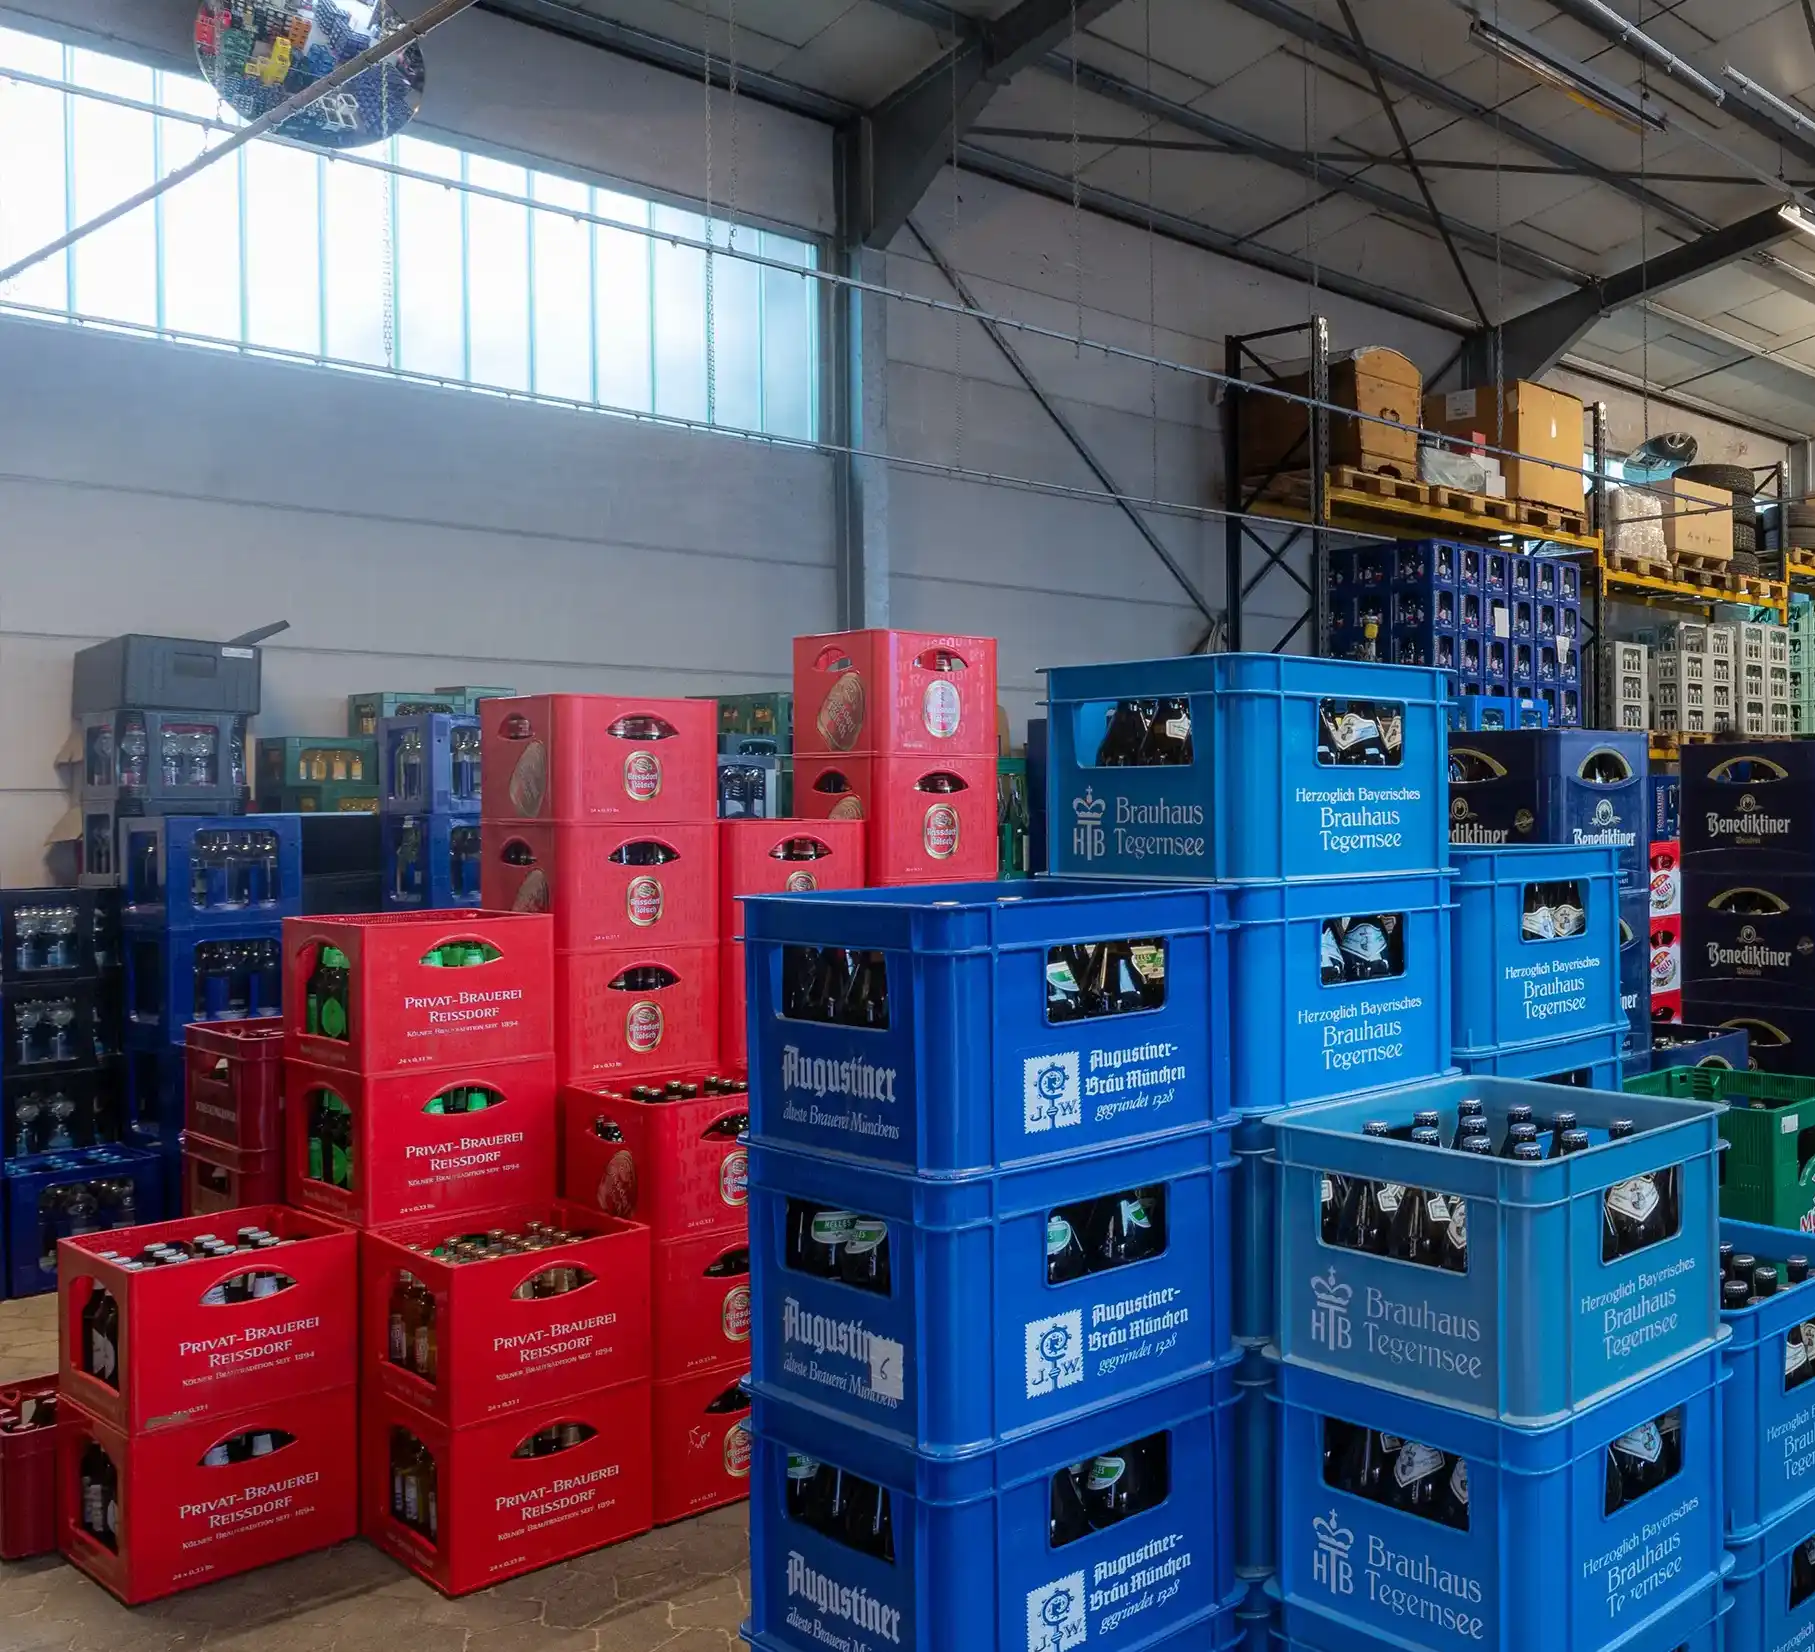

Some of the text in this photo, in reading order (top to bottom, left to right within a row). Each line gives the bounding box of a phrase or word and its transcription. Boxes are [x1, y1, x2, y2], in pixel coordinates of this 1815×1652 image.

[1115, 797, 1204, 826] Brauhaus
[1296, 786, 1421, 804] Herzoglich Bayerisches
[1320, 806, 1401, 828] Brauhaus
[1706, 812, 1791, 838] Benediktiner
[1114, 827, 1205, 858] Tegernsee
[1319, 829, 1402, 853] Tegernsee
[1505, 955, 1600, 980] Herzoglich Bayerisches
[1706, 941, 1792, 967] Benediktiner
[404, 989, 522, 1009] PRIVAT-BRAUEREI
[1523, 976, 1585, 996] Brauhaus
[428, 1007, 500, 1023] REISSDORF
[1298, 997, 1422, 1026] Herzoglich Bayerisches
[1523, 995, 1586, 1020] Tegernsee
[1323, 1019, 1402, 1047] Brauhaus
[782, 1043, 897, 1104] Augustiner
[1090, 1042, 1178, 1072] Augustiner-
[1322, 1042, 1403, 1071] Tegernsee
[1085, 1063, 1186, 1097] Bräu München
[783, 1104, 900, 1141] älteste Brauerei Münchens
[1095, 1089, 1175, 1122] gegründet 1328
[406, 1132, 524, 1159] PRIVAT-BRAUEREI
[430, 1151, 501, 1171] REISSDORF
[824, 1219, 852, 1230] HELLES
[1581, 1256, 1696, 1314] Herzoglich Bayerisches
[1092, 1287, 1181, 1328] Augustiner-
[1366, 1287, 1481, 1343] Brauhaus
[1603, 1287, 1676, 1335] Brauhaus
[179, 1316, 320, 1356] PRIVAT-BRAUEREI
[494, 1313, 617, 1352] PRIVAT-BRAUEREI
[1088, 1307, 1189, 1353] Bräu München
[1603, 1312, 1679, 1361] Tegernsee
[208, 1339, 293, 1368] REISSDORF
[519, 1335, 593, 1363] REISSDORF
[1097, 1333, 1177, 1377] gegründet 1328
[1363, 1321, 1482, 1379] Tegernsee
[783, 1352, 848, 1390] älteste Brauerei
[1767, 1407, 1808, 1442] Herzoglich
[179, 1471, 320, 1520] PRIVAT-BRAUEREI
[495, 1464, 620, 1512] PRIVAT-BRAUEREI
[521, 1489, 596, 1521] REISSDORF
[209, 1496, 293, 1529] REISSDORF
[1583, 1496, 1699, 1579] Herzoglich Bayerisches
[1093, 1532, 1184, 1585] Augustiner-
[1367, 1535, 1483, 1603] Brauhaus
[1607, 1532, 1681, 1594] Brauhaus
[786, 1550, 901, 1645] Augustiner
[1090, 1553, 1192, 1611] Bräu München
[1099, 1580, 1181, 1635] gegründet 1328
[1364, 1569, 1484, 1640] Tegernsee
[786, 1606, 852, 1652] älteste Brauerei
